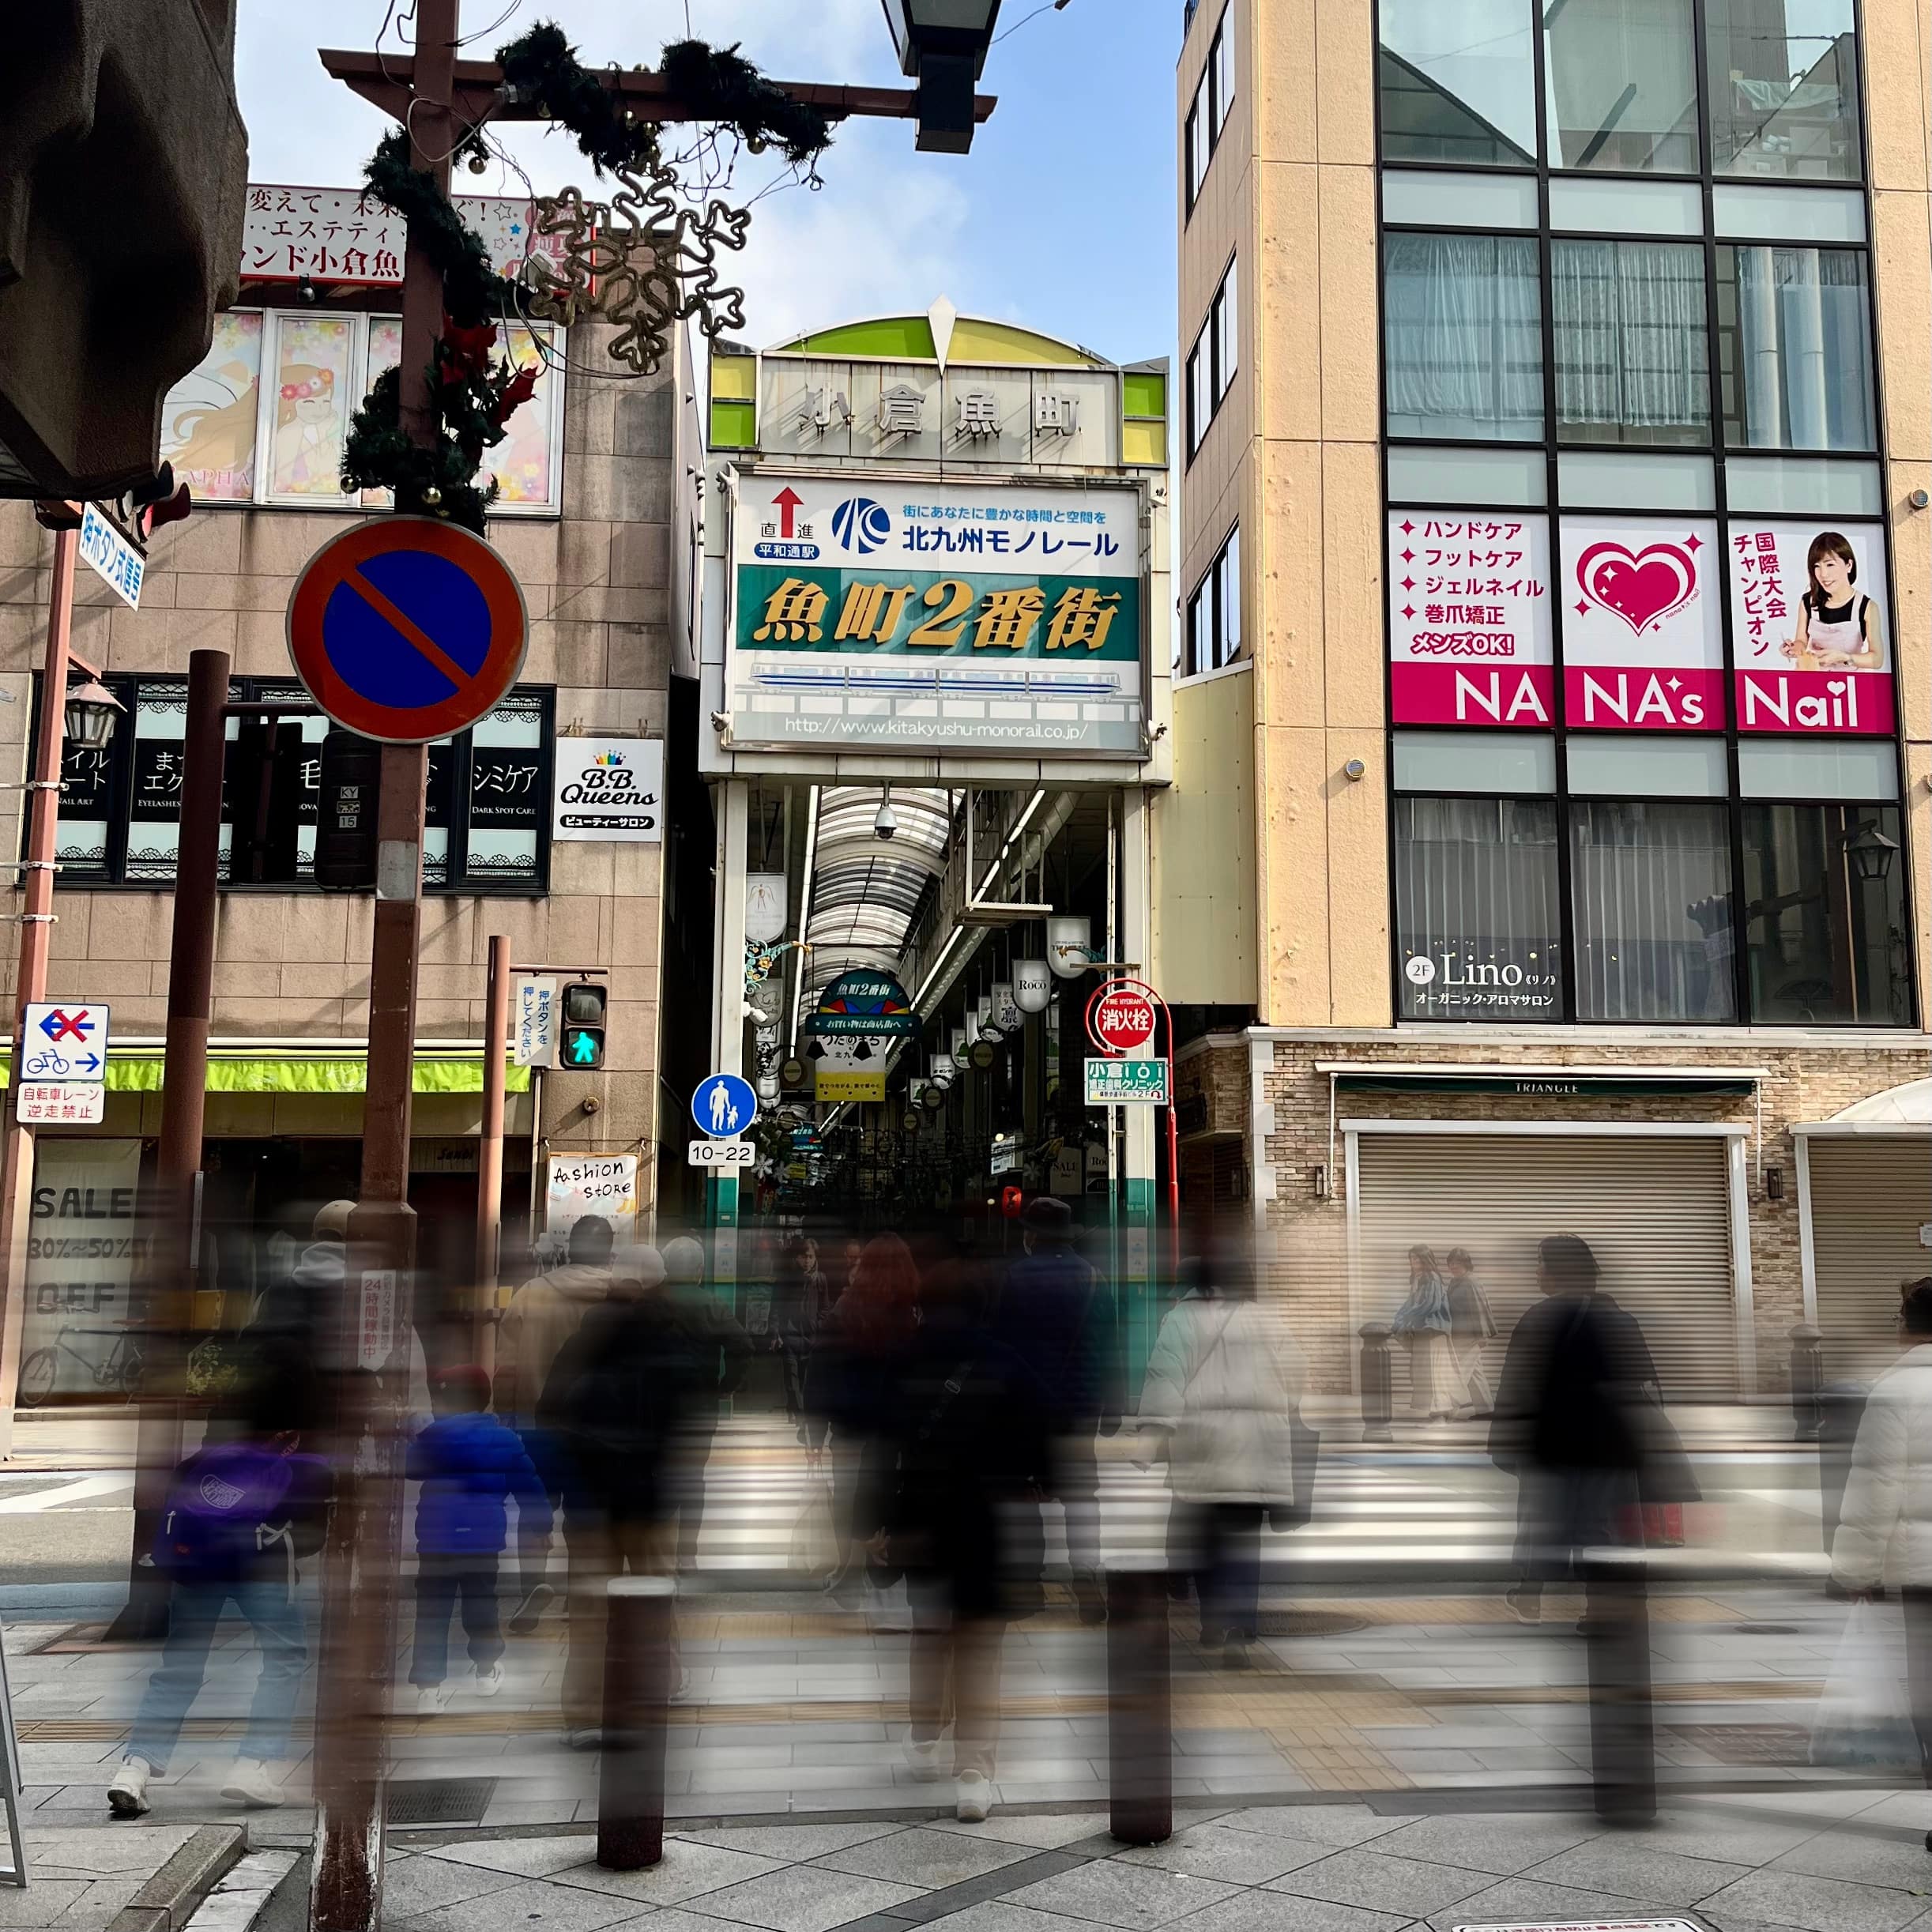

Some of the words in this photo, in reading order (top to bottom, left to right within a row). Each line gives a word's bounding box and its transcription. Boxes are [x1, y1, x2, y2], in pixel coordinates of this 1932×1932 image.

[240, 244, 401, 277] ンド小倉魚
[800, 381, 1080, 437] 小倉魚町
[902, 503, 1106, 525] 街にあなたに豊かな時間と空間を
[1423, 520, 1523, 540] ハンドケア
[758, 544, 815, 559] 平和通駅
[902, 525, 1119, 558] 北九州モノレール
[81, 508, 141, 601] 押ボタン式信号
[1424, 549, 1523, 568] フットケア
[1425, 576, 1545, 597] ジェルネイル
[1754, 532, 1787, 619] 国際大会
[1734, 534, 1769, 657] チャンピオン
[753, 577, 1123, 650] 魚町2番街
[1425, 604, 1505, 626] 巻爪矯正
[1410, 631, 1516, 657] メンズOK!
[1745, 675, 1858, 728] Nail
[785, 716, 1089, 741] http://www.kitakyushu-monorail.co.jp/
[60, 750, 111, 769] イル
[60, 770, 106, 791] ート
[473, 763, 539, 793] シミケア
[581, 768, 637, 790] B.B.
[341, 787, 358, 798] KY
[560, 783, 659, 806] Queens
[340, 816, 356, 827] 15
[565, 815, 649, 828] ビューティーサロン
[1412, 963, 1430, 977] 2F
[1440, 953, 1523, 987] Lino
[1415, 992, 1554, 1007] オーガニック・アロマサロン
[537, 990, 550, 1045] 押ボタンを
[1102, 1007, 1151, 1031] 消火栓
[24, 1087, 100, 1101] 自転車レーン
[1515, 1082, 1578, 1094] TRIANGLE
[27, 1104, 93, 1119] 逆走禁止
[692, 1146, 750, 1161] 10-22
[33, 1187, 134, 1219] SALE
[36, 1282, 116, 1315] OFF
